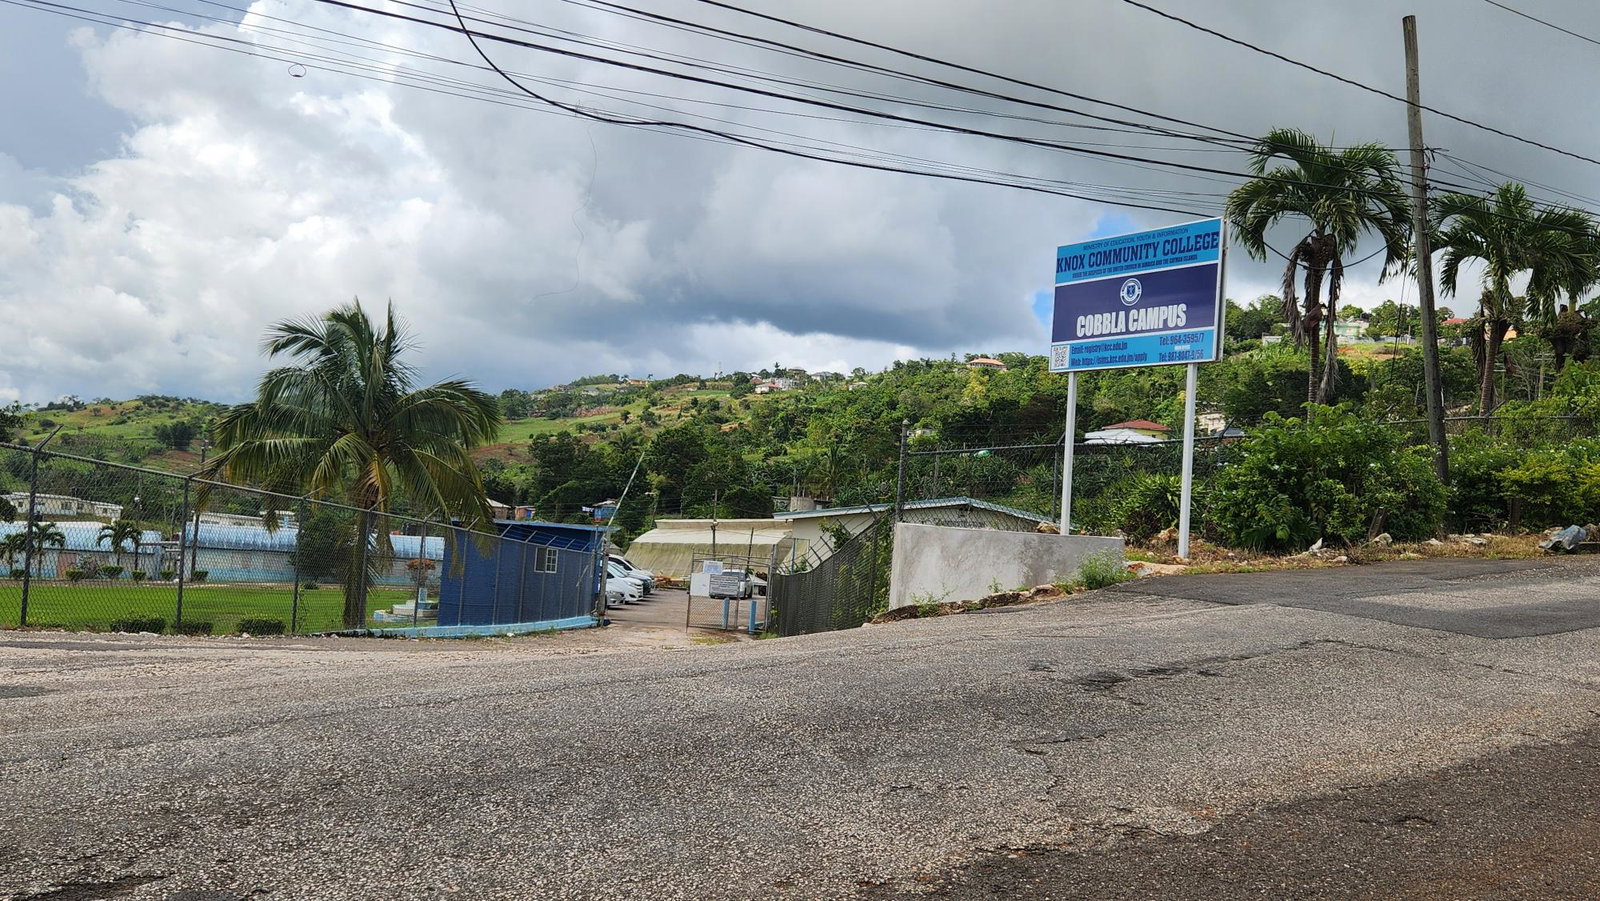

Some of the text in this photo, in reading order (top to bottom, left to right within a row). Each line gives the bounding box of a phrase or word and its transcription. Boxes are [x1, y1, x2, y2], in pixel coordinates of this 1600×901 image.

[1157, 228, 1188, 238] INFORMATION
[1056, 231, 1219, 273] KNOX COMMUNITY COLLEGE
[1077, 303, 1187, 338] COBBLA CAMPUS
